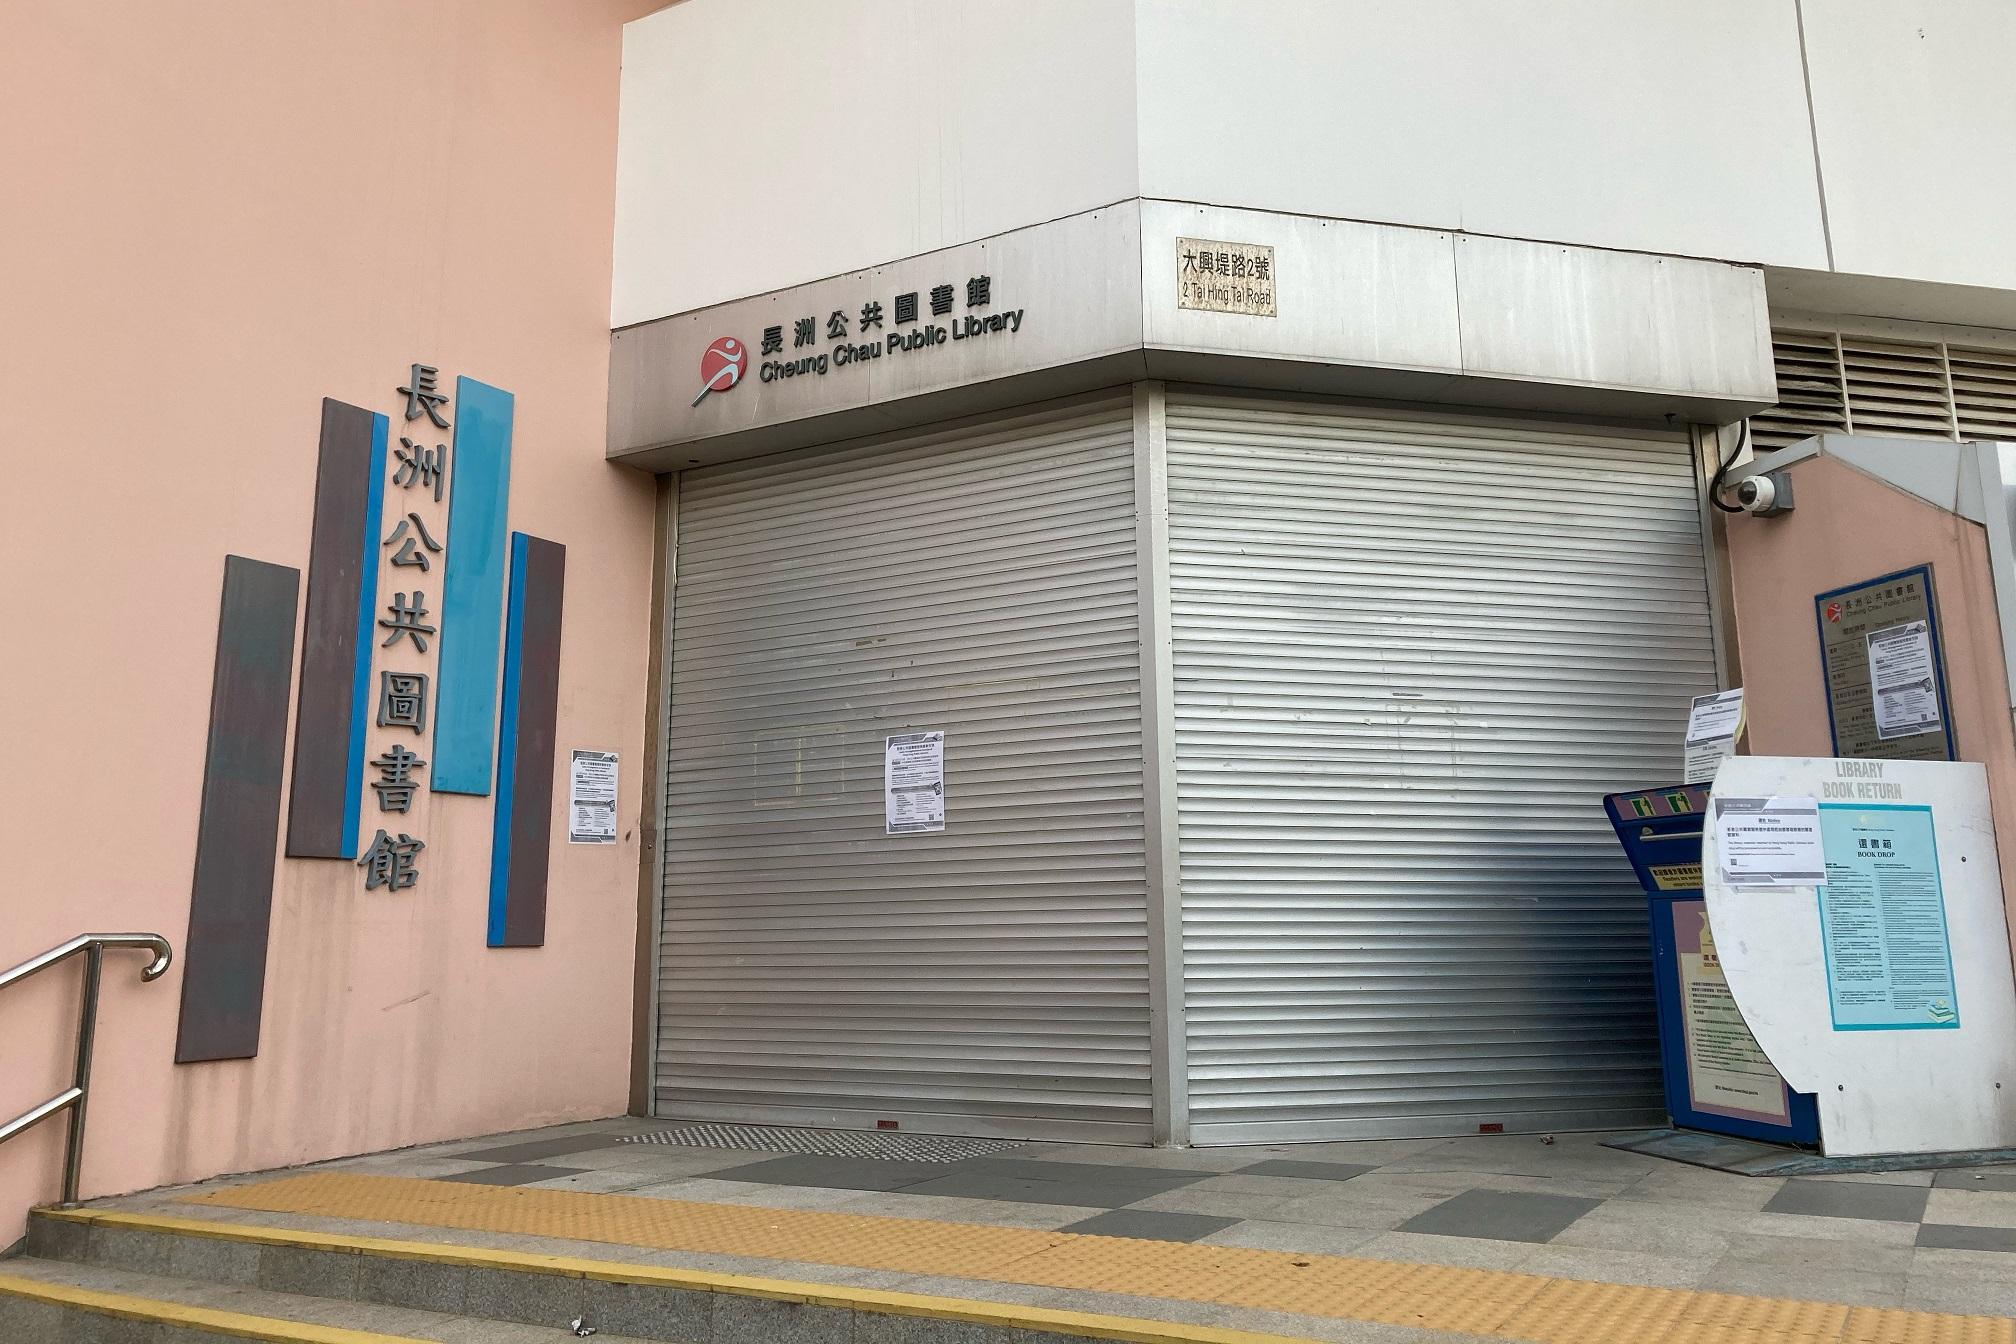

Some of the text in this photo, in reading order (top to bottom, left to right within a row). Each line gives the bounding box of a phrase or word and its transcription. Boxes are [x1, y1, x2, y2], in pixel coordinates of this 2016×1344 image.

[1182, 248, 1270, 281] 大興堤路2號
[1182, 281, 1271, 306] 2 Tai Hing Tai Road
[760, 274, 992, 356] 長洲公共圖書館
[759, 307, 1024, 383] Cheung Chau Public Library
[356, 362, 452, 892] 長洲公共圖書館
[1835, 761, 1883, 778] LIBRARY
[1823, 781, 1903, 800] BOOK RETURN
